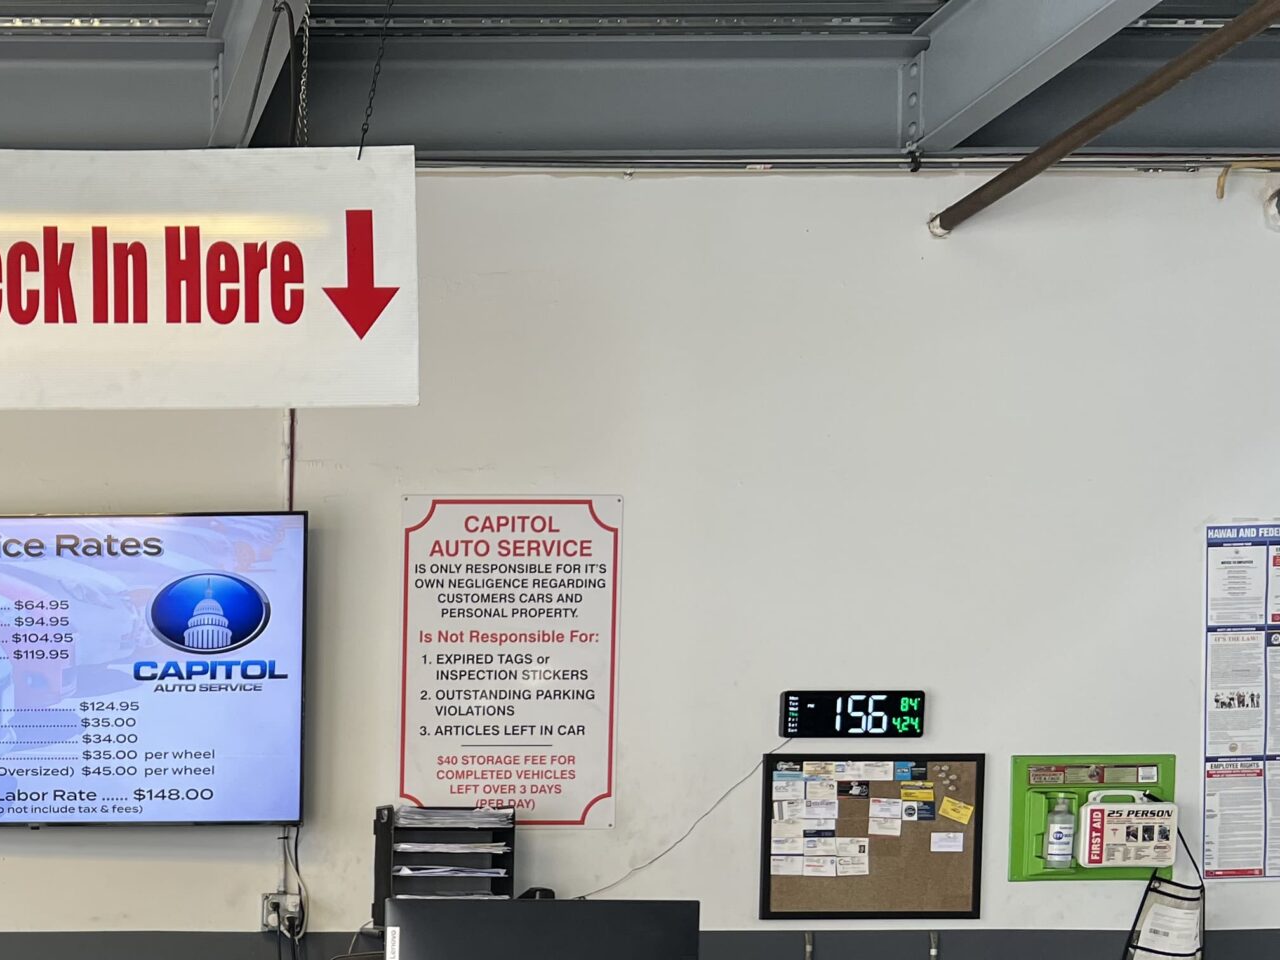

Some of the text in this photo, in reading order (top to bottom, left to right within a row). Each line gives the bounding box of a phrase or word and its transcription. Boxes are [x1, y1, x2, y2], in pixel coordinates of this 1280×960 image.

[91, 225, 149, 325] In
[164, 225, 305, 325] Here
[464, 515, 560, 533] CAPITOL
[1208, 529, 1236, 538] HAWAII
[1239, 528, 1256, 537] AND
[55, 533, 164, 558] Rates
[429, 540, 593, 556] AUTO SERVICE
[415, 564, 607, 573] IS ONLY RESPONSIBLE FOR IT'S
[414, 579, 606, 589] OWN NEGLIGENCE REGARDING
[437, 593, 583, 603] CUSTOMERS CARS AND
[14, 599, 70, 612] $64.95
[441, 608, 579, 618] PERSONAL PROPERTY.
[14, 616, 70, 629] $94.95
[11, 632, 73, 645] $104.95
[419, 630, 599, 646] Is Not Responsible For:
[13, 649, 70, 661] $119.95
[422, 654, 550, 664] 1. EXPIRED TAGS or
[133, 659, 289, 682] CAPITOL
[436, 670, 588, 680] INSPECTION STICKERS
[153, 683, 263, 693] AUTO SERVICE
[420, 690, 595, 700] 2. OUTSTANDING PARKING
[79, 700, 140, 713] $124.95
[435, 706, 514, 716] VIOLATIONS
[835, 695, 887, 733] 156
[80, 716, 136, 729] $35.00
[420, 726, 586, 736] 3. ARTICLES LEFT IN CAR
[82, 733, 138, 745] $34.00
[82, 749, 137, 762] $35.00
[144, 751, 169, 764] per
[171, 749, 216, 760] wheel
[437, 755, 575, 766] $40 STORAGE FEE FOR
[81, 765, 137, 778] $45.00
[144, 767, 169, 780] per
[171, 764, 216, 776] wheel
[437, 770, 576, 780] COMPLETED VEHICLES
[54, 789, 97, 802] Rate
[133, 787, 214, 803] $148.00
[450, 785, 561, 794] LEFT OVER 3 DAYS
[8, 805, 28, 814] not
[31, 805, 76, 814] include
[78, 805, 98, 814] tax
[100, 805, 109, 814] &
[112, 805, 144, 816] fees)
[476, 799, 535, 810] (PER DAY)
[1091, 812, 1101, 859] FIRST AID
